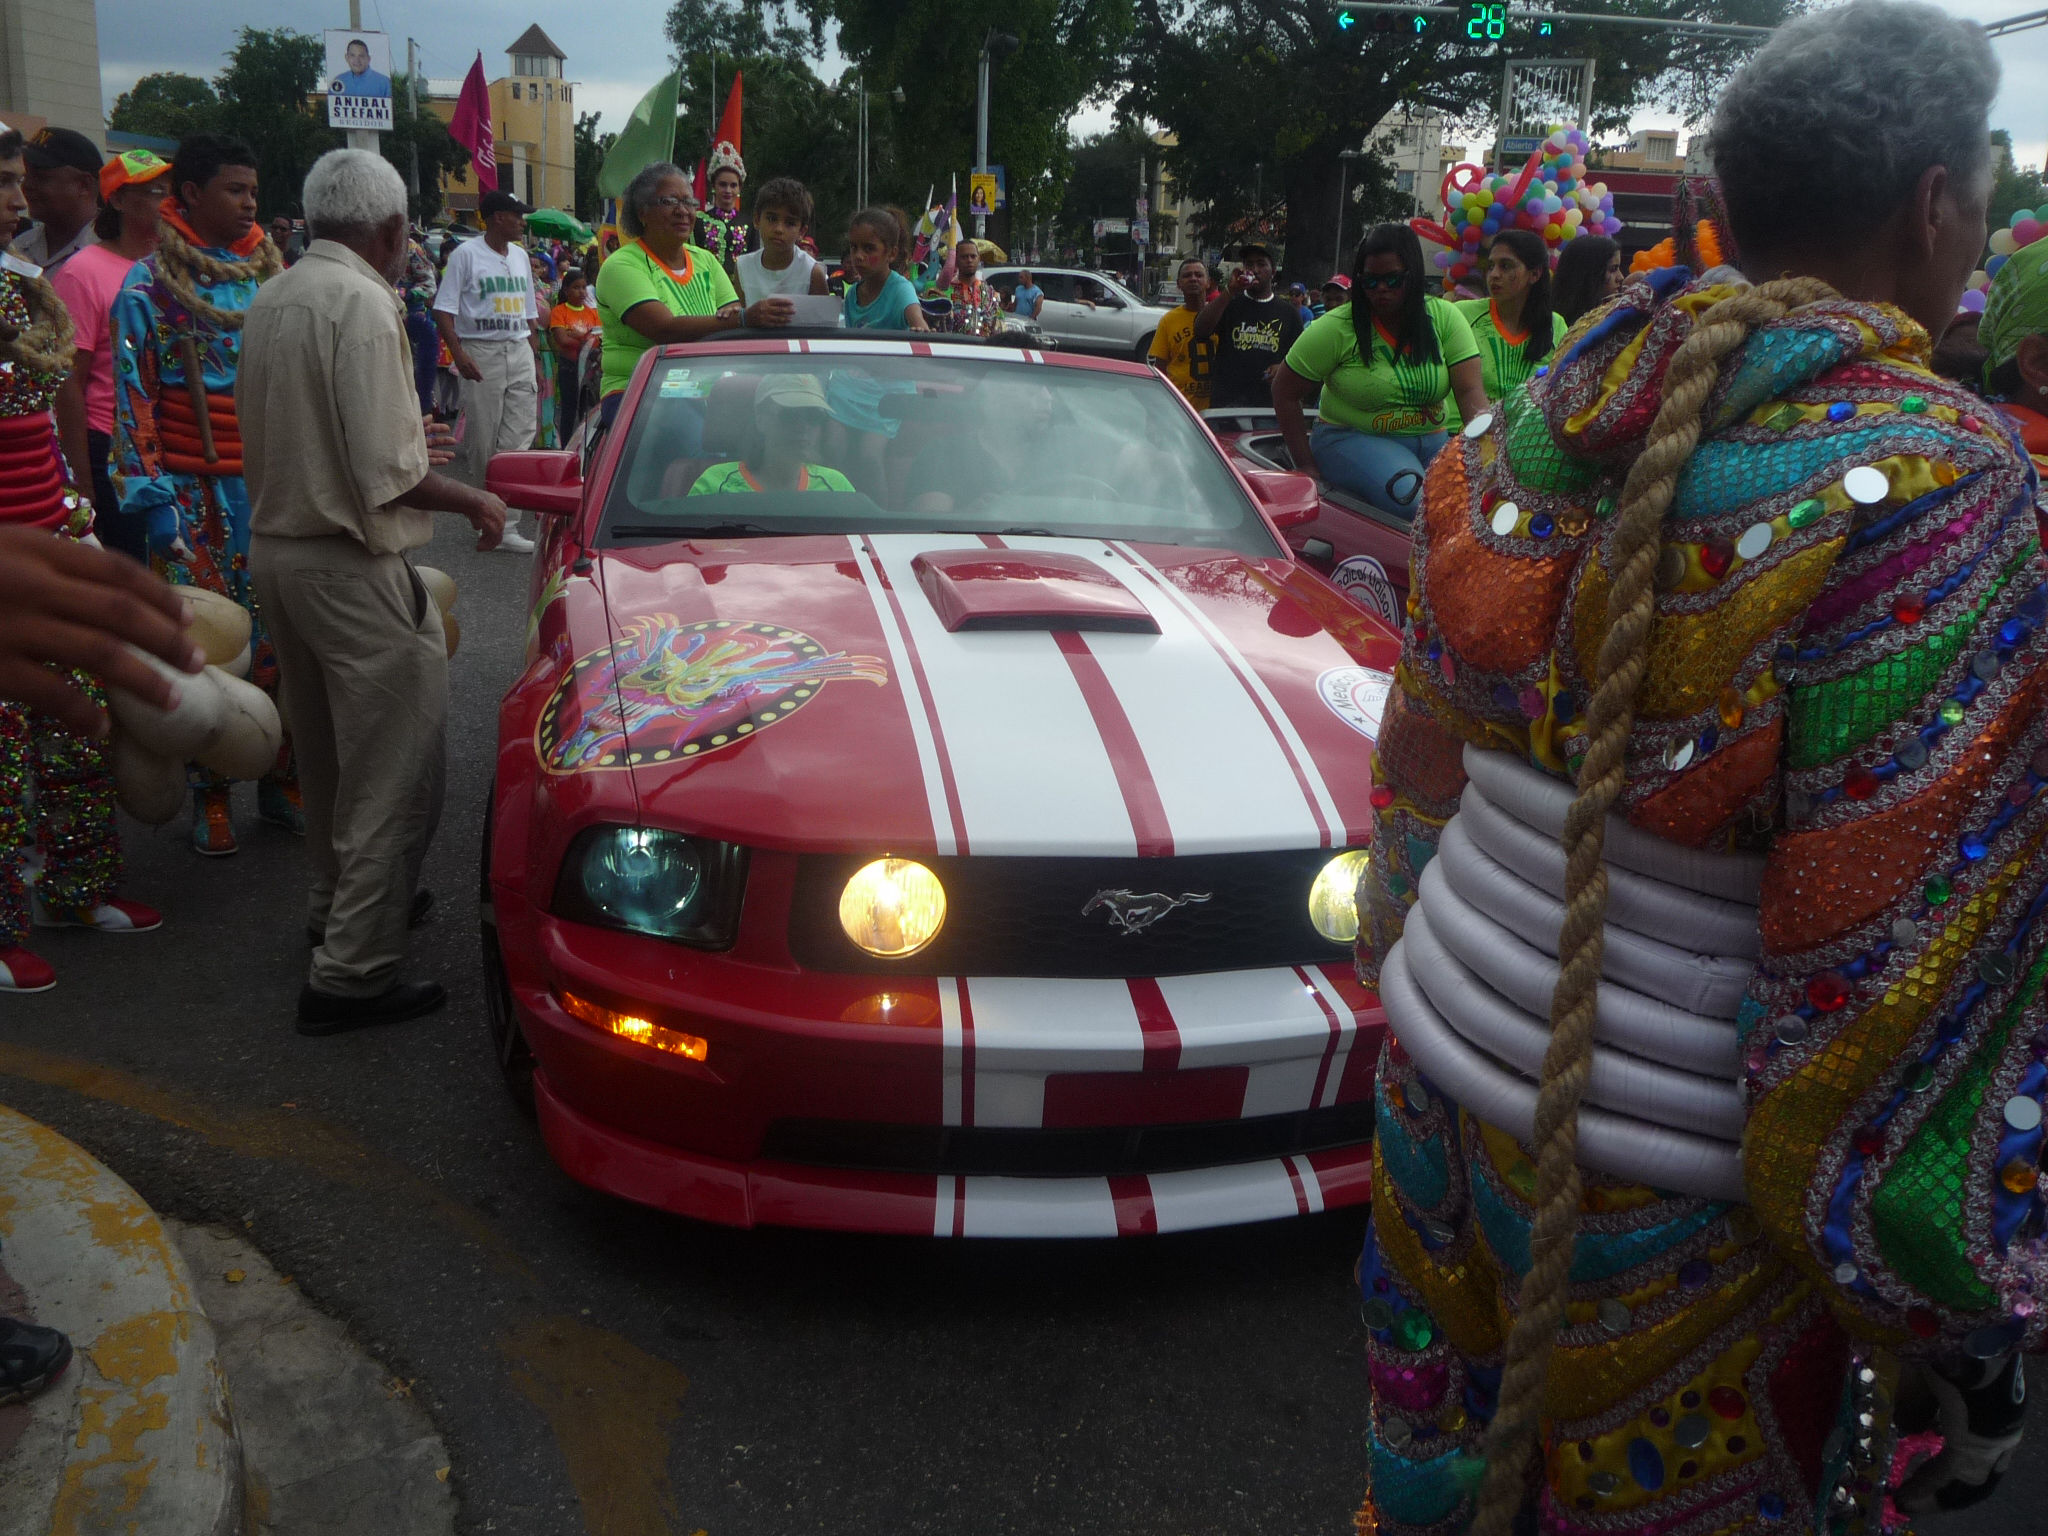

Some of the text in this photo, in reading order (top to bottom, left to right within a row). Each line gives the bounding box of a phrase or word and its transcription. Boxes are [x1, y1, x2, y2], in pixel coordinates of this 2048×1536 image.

[1467, 3, 1505, 39] 28
[334, 96, 387, 108] ANIBAL
[333, 107, 389, 119] STEFANI
[1505, 140, 1533, 150] Abierto
[475, 318, 510, 331] TRACK
[1240, 321, 1258, 333] Los
